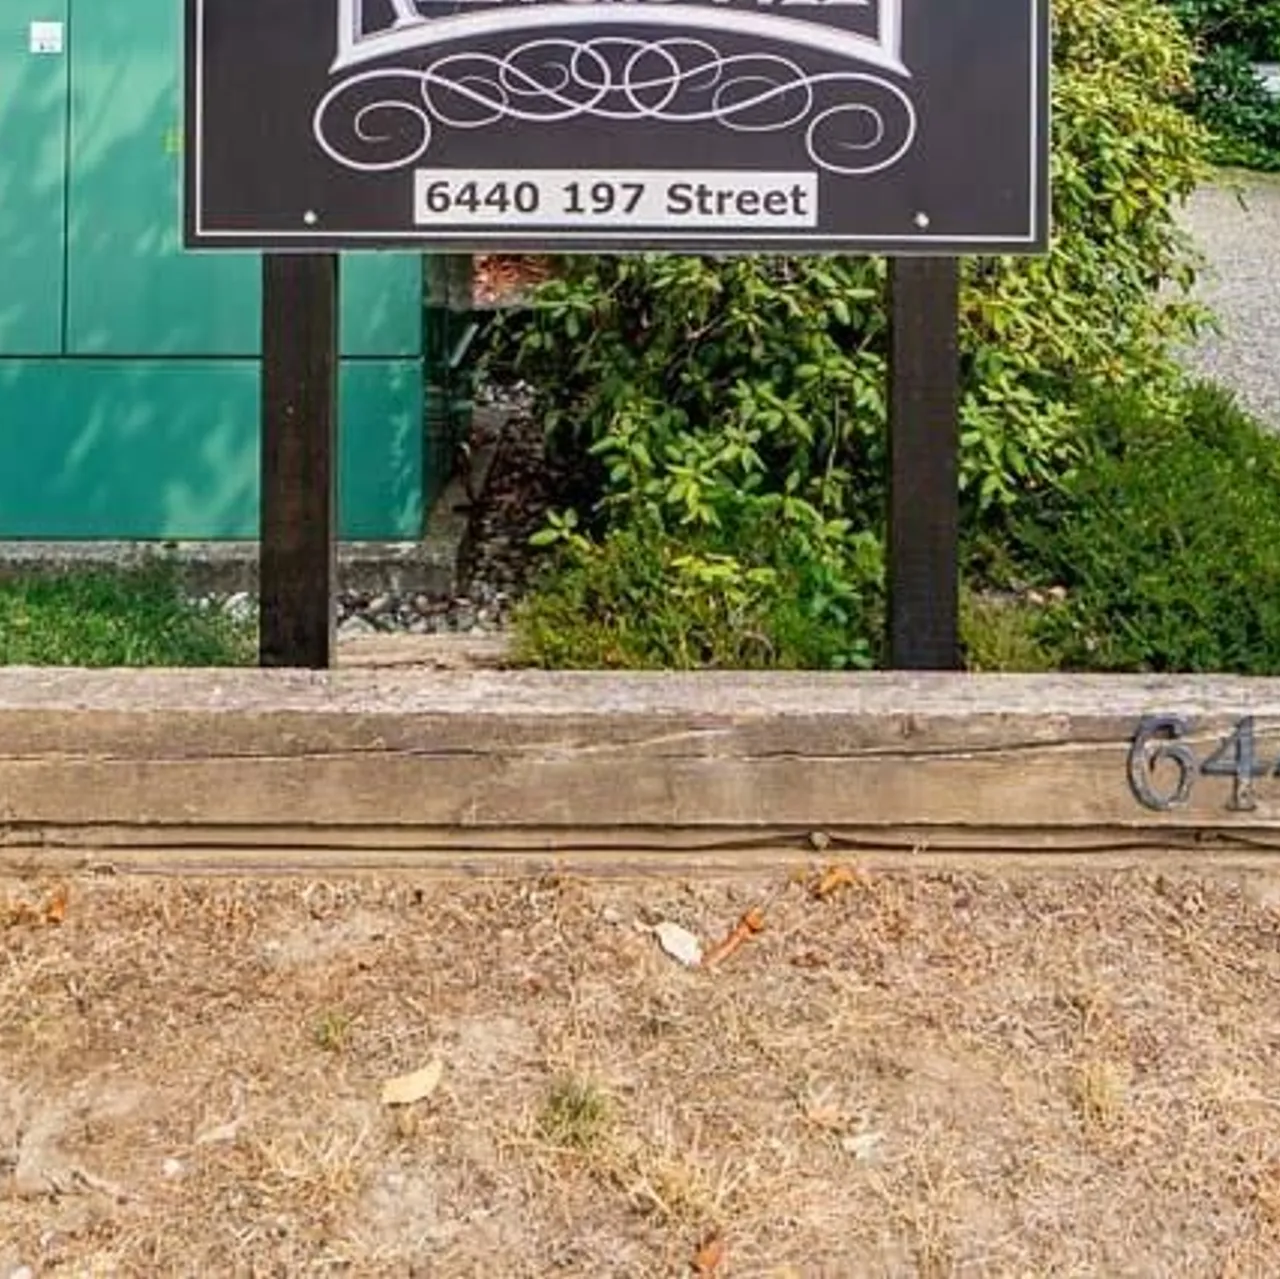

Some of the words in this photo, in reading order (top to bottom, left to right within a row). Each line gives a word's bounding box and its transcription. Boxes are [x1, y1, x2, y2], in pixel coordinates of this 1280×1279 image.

[425, 181, 540, 214] 6440
[563, 182, 645, 214] 197
[666, 183, 809, 216] Street
